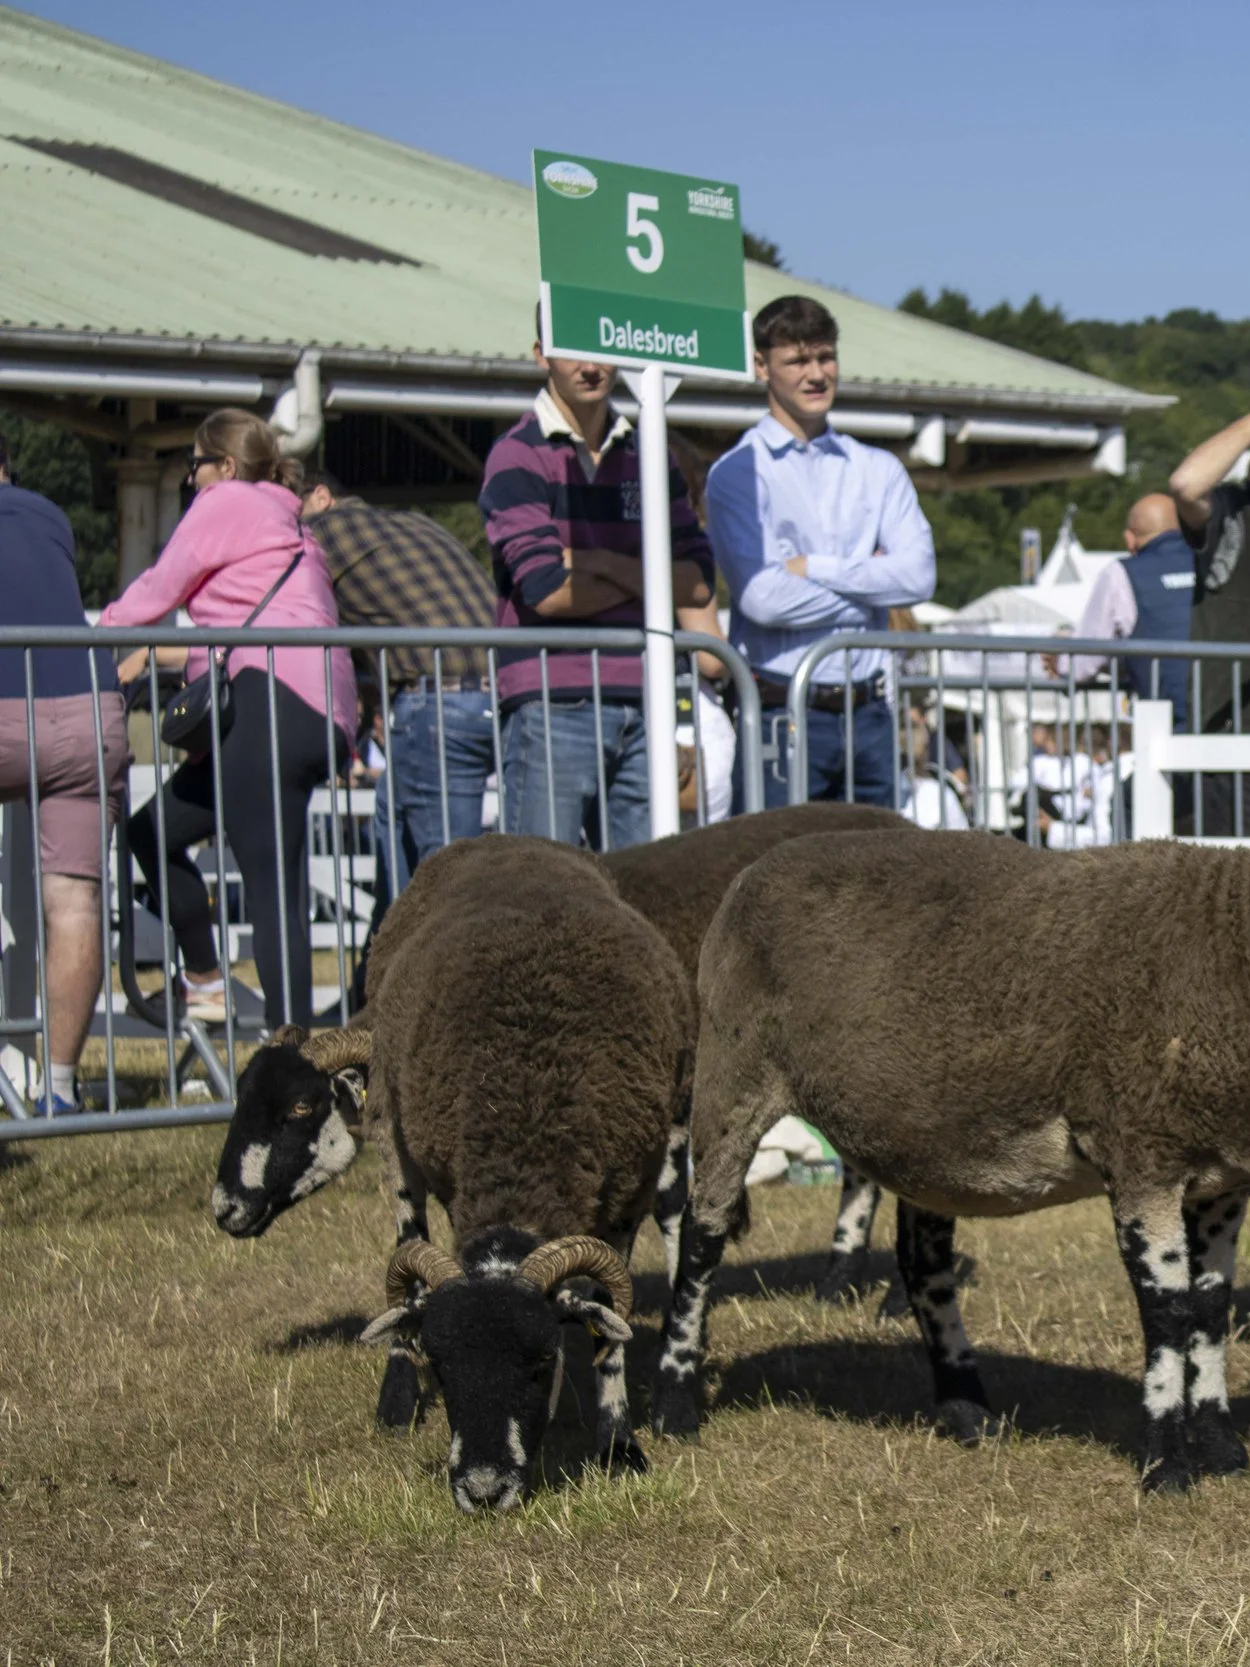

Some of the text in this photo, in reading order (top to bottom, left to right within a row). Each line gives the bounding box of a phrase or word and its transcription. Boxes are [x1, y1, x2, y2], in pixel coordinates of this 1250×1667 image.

[688, 190, 734, 212] YORKSHIRE
[626, 192, 664, 274] 5
[599, 316, 699, 359] Dalesbred
